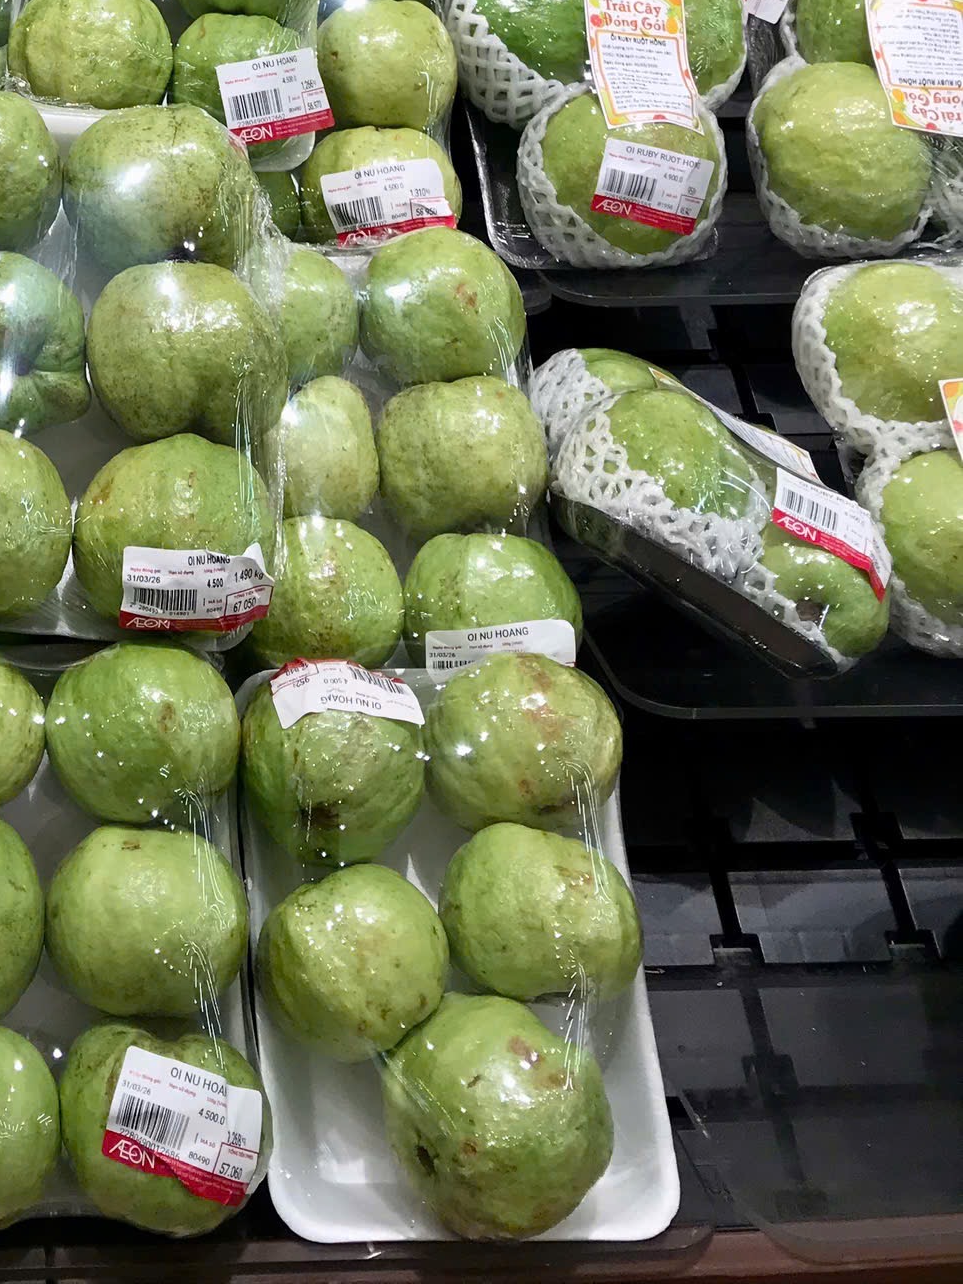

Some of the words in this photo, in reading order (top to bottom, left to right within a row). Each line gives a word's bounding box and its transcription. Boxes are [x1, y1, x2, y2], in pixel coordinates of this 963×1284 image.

[633, 3, 662, 17] Cây
[602, 13, 638, 31] Đóng
[642, 16, 666, 32] Gói
[626, 146, 635, 154] OI
[637, 148, 658, 158] RUBY
[660, 153, 681, 163] RUOT
[595, 200, 631, 217] ÆON
[188, 556, 195, 566] OI
[196, 556, 205, 565] NU
[207, 554, 230, 564] HOANG
[127, 574, 161, 584] 31/03/26
[233, 597, 256, 613] 67.050
[467, 632, 477, 641] OI
[479, 630, 493, 640] NU
[495, 626, 529, 638] HOANG
[109, 1139, 156, 1169] ÆON
[219, 1162, 243, 1180] 57.060
